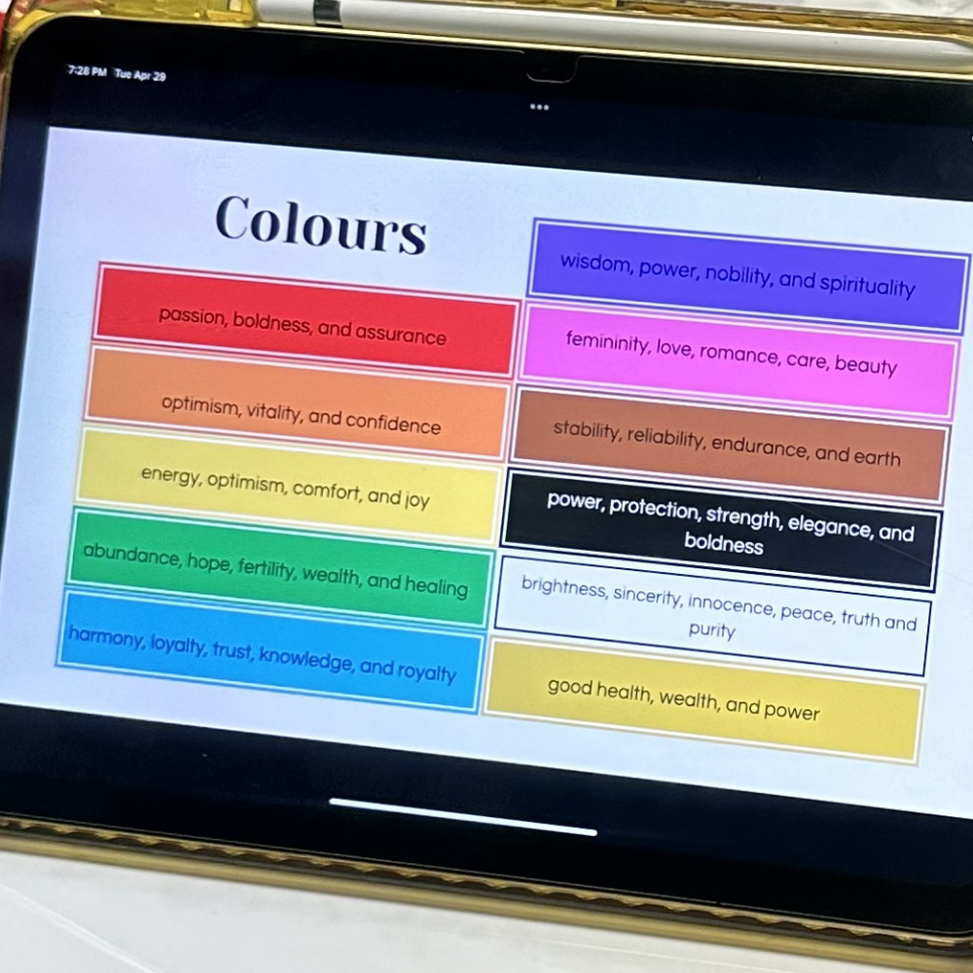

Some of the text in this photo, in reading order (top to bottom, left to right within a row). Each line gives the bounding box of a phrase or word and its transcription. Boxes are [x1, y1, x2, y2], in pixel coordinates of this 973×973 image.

[91, 66, 108, 77] PM
[115, 68, 167, 82] Tue Apr 29
[216, 195, 427, 257] Colours
[560, 251, 917, 302] wisdom, power, nobility, and spirituality
[158, 305, 448, 348] passion, boldness, and assurance
[565, 329, 899, 379] femininity, love, romance, care, beauty
[161, 394, 442, 436] optimism, vitality, and confidence
[553, 419, 902, 468] stability, reliability, endurance, and earth
[140, 465, 431, 512] energy, optimism, comfort, and joy
[546, 491, 915, 543] power, protection, strength, elegance, and
[684, 531, 765, 557] boldness
[82, 542, 470, 601] abundance, hope, fertility, wealth, and healing
[521, 575, 918, 632] brightness, sincerity, innocence, peace, truth and
[68, 624, 458, 687] harmony, loyalty, trust, knowledge, and royalty
[688, 620, 737, 643] purity
[547, 677, 821, 723] good health, wealth, and power
